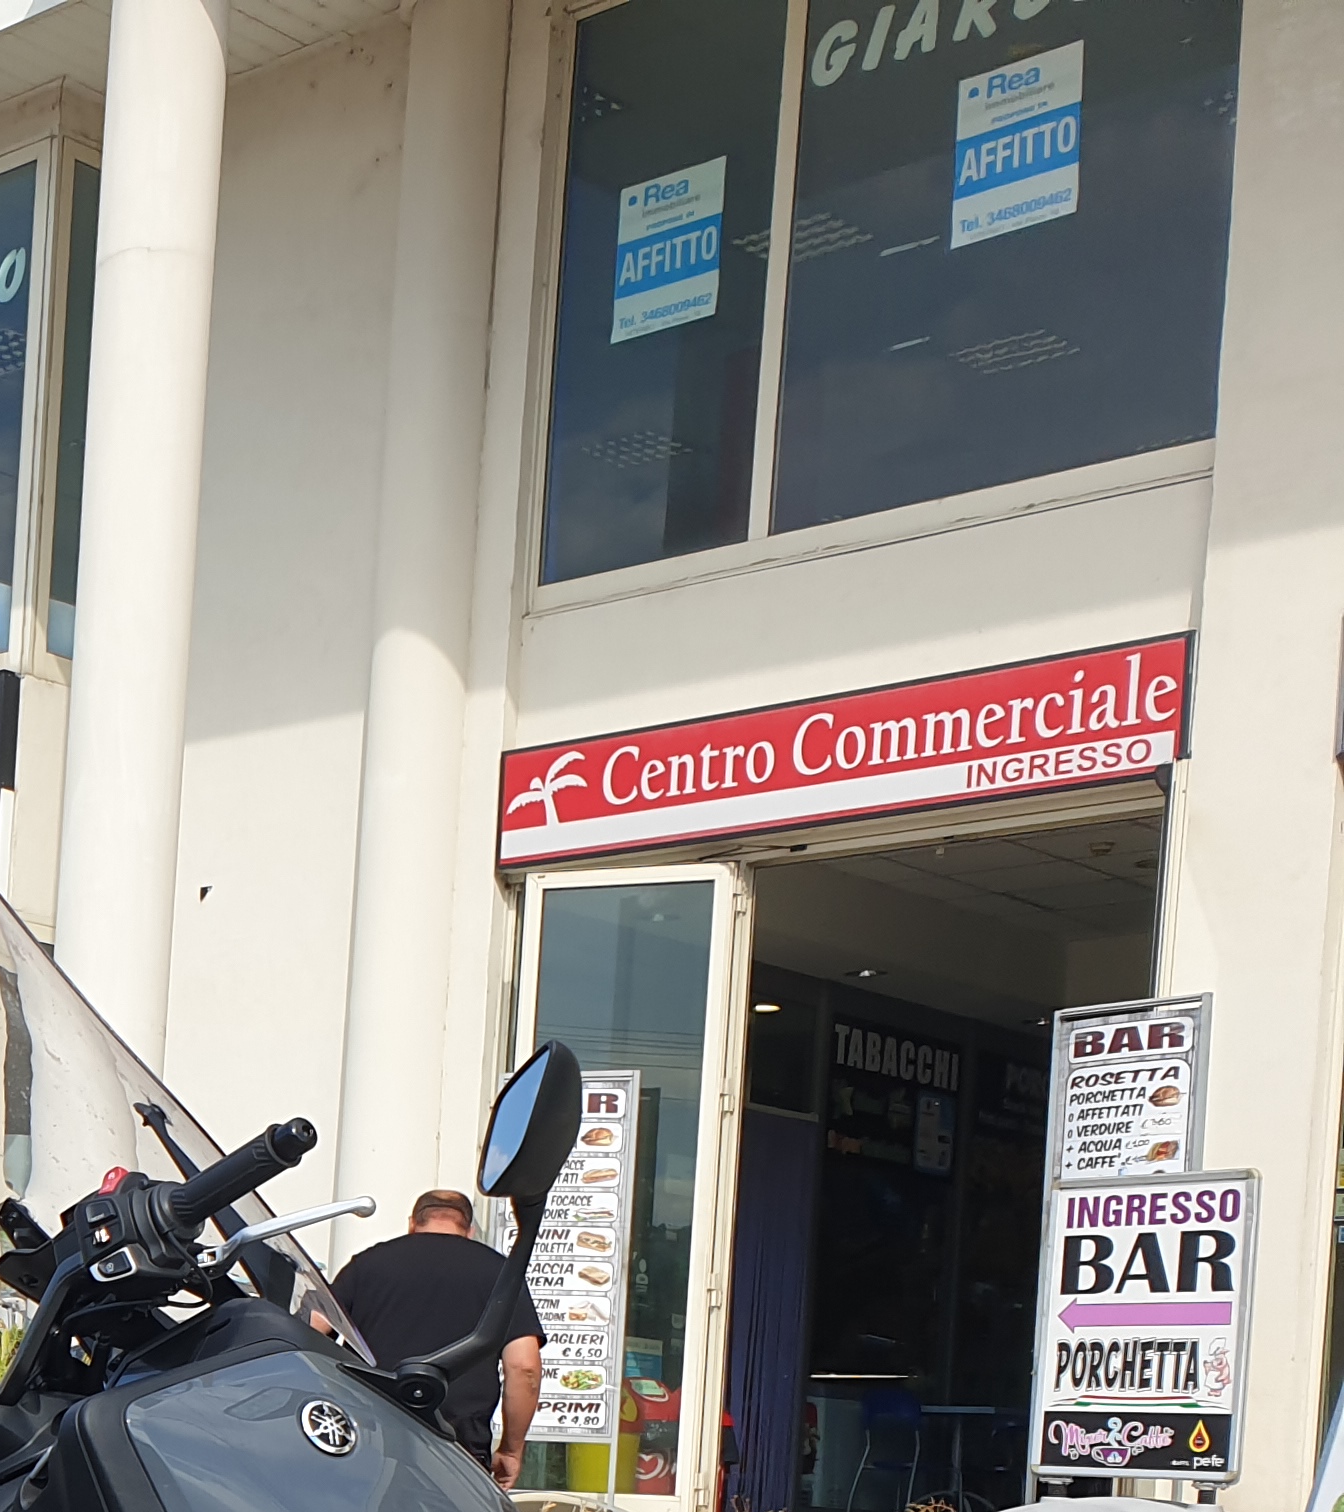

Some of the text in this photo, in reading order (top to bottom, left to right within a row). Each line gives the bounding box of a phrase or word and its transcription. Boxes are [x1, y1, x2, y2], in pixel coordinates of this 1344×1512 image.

[987, 67, 1040, 98] Rea
[959, 116, 1077, 186] AFFITTO
[644, 179, 689, 207] Rea
[619, 225, 717, 286] AFFITTO
[601, 653, 1178, 805] Centro Commerciale
[965, 738, 1152, 790] INGRESSO
[1073, 1022, 1185, 1058] BAR
[835, 1023, 959, 1091] TABACCHI
[1070, 1066, 1180, 1090] ROSETTA
[1069, 1086, 1147, 1107] PORCHETTA
[1076, 1104, 1144, 1121] AFFETTATI
[1076, 1121, 1134, 1138] VERDURE
[1078, 1138, 1122, 1154] ACQUA
[563, 1160, 586, 1170] ACCE
[557, 1173, 578, 1184] TATI
[551, 1195, 593, 1206] FOCACCE
[1066, 1189, 1241, 1228] INGRESSO
[544, 1209, 570, 1219] DURE
[535, 1243, 574, 1253] TOLETTA
[1060, 1230, 1236, 1295] BAR
[562, 1348, 602, 1359] € 6,50
[1054, 1337, 1200, 1392] PORCHETTA
[537, 1402, 602, 1414] PRIMI
[558, 1415, 599, 1427] € 4,80
